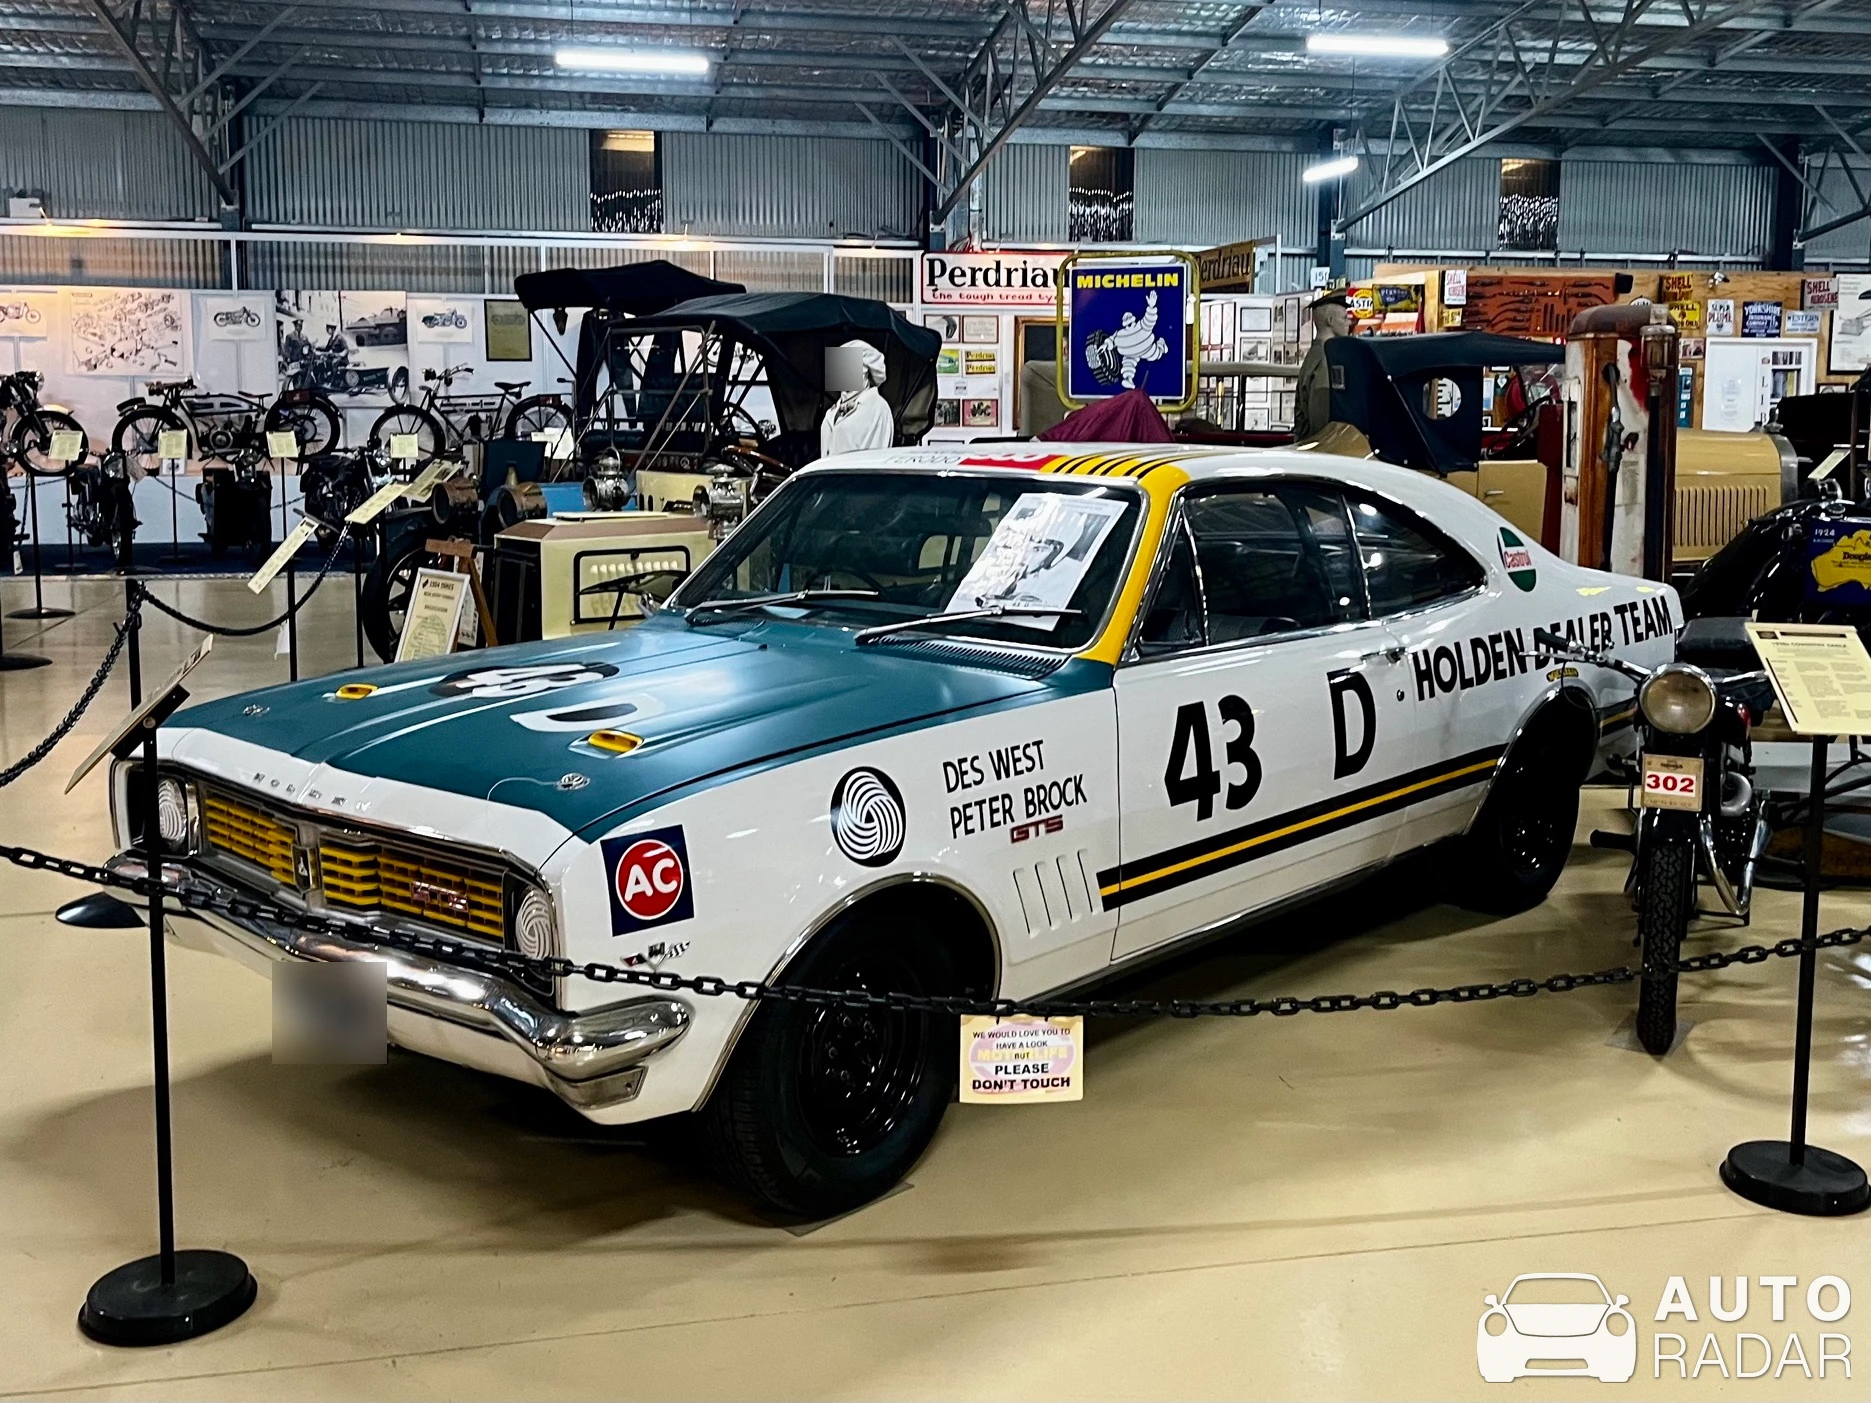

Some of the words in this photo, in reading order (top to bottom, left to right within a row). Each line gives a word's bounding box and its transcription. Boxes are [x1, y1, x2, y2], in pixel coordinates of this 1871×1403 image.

[926, 258, 1070, 289] Perdriau
[1199, 250, 1250, 281] erdriau
[1077, 273, 1179, 289] MICHELIN
[959, 292, 994, 300] tough
[1000, 292, 1032, 300] tread
[1814, 528, 1836, 537] 1924
[1503, 549, 1532, 568] Castrol
[1412, 627, 1528, 702] HOLDEN
[1613, 595, 1673, 646] TEAM
[1164, 694, 1262, 822] 43
[1326, 667, 1377, 780] D
[942, 755, 985, 794] DES
[988, 739, 1044, 781] WEST
[1646, 774, 1694, 793] 302
[950, 793, 1015, 839] PETER
[1023, 774, 1088, 819] BROCK
[1010, 814, 1064, 844] GTS
[624, 857, 678, 902] AC
[972, 1031, 986, 1039] WE
[987, 1030, 1017, 1039] WOULD
[1018, 1029, 1039, 1038] LOVE
[1042, 1028, 1058, 1036] YOU
[996, 1042, 1017, 1050] HAVE
[995, 1063, 1049, 1075] PLEASE
[972, 1079, 1017, 1090] DON'T
[1021, 1077, 1071, 1089] TOUCH
